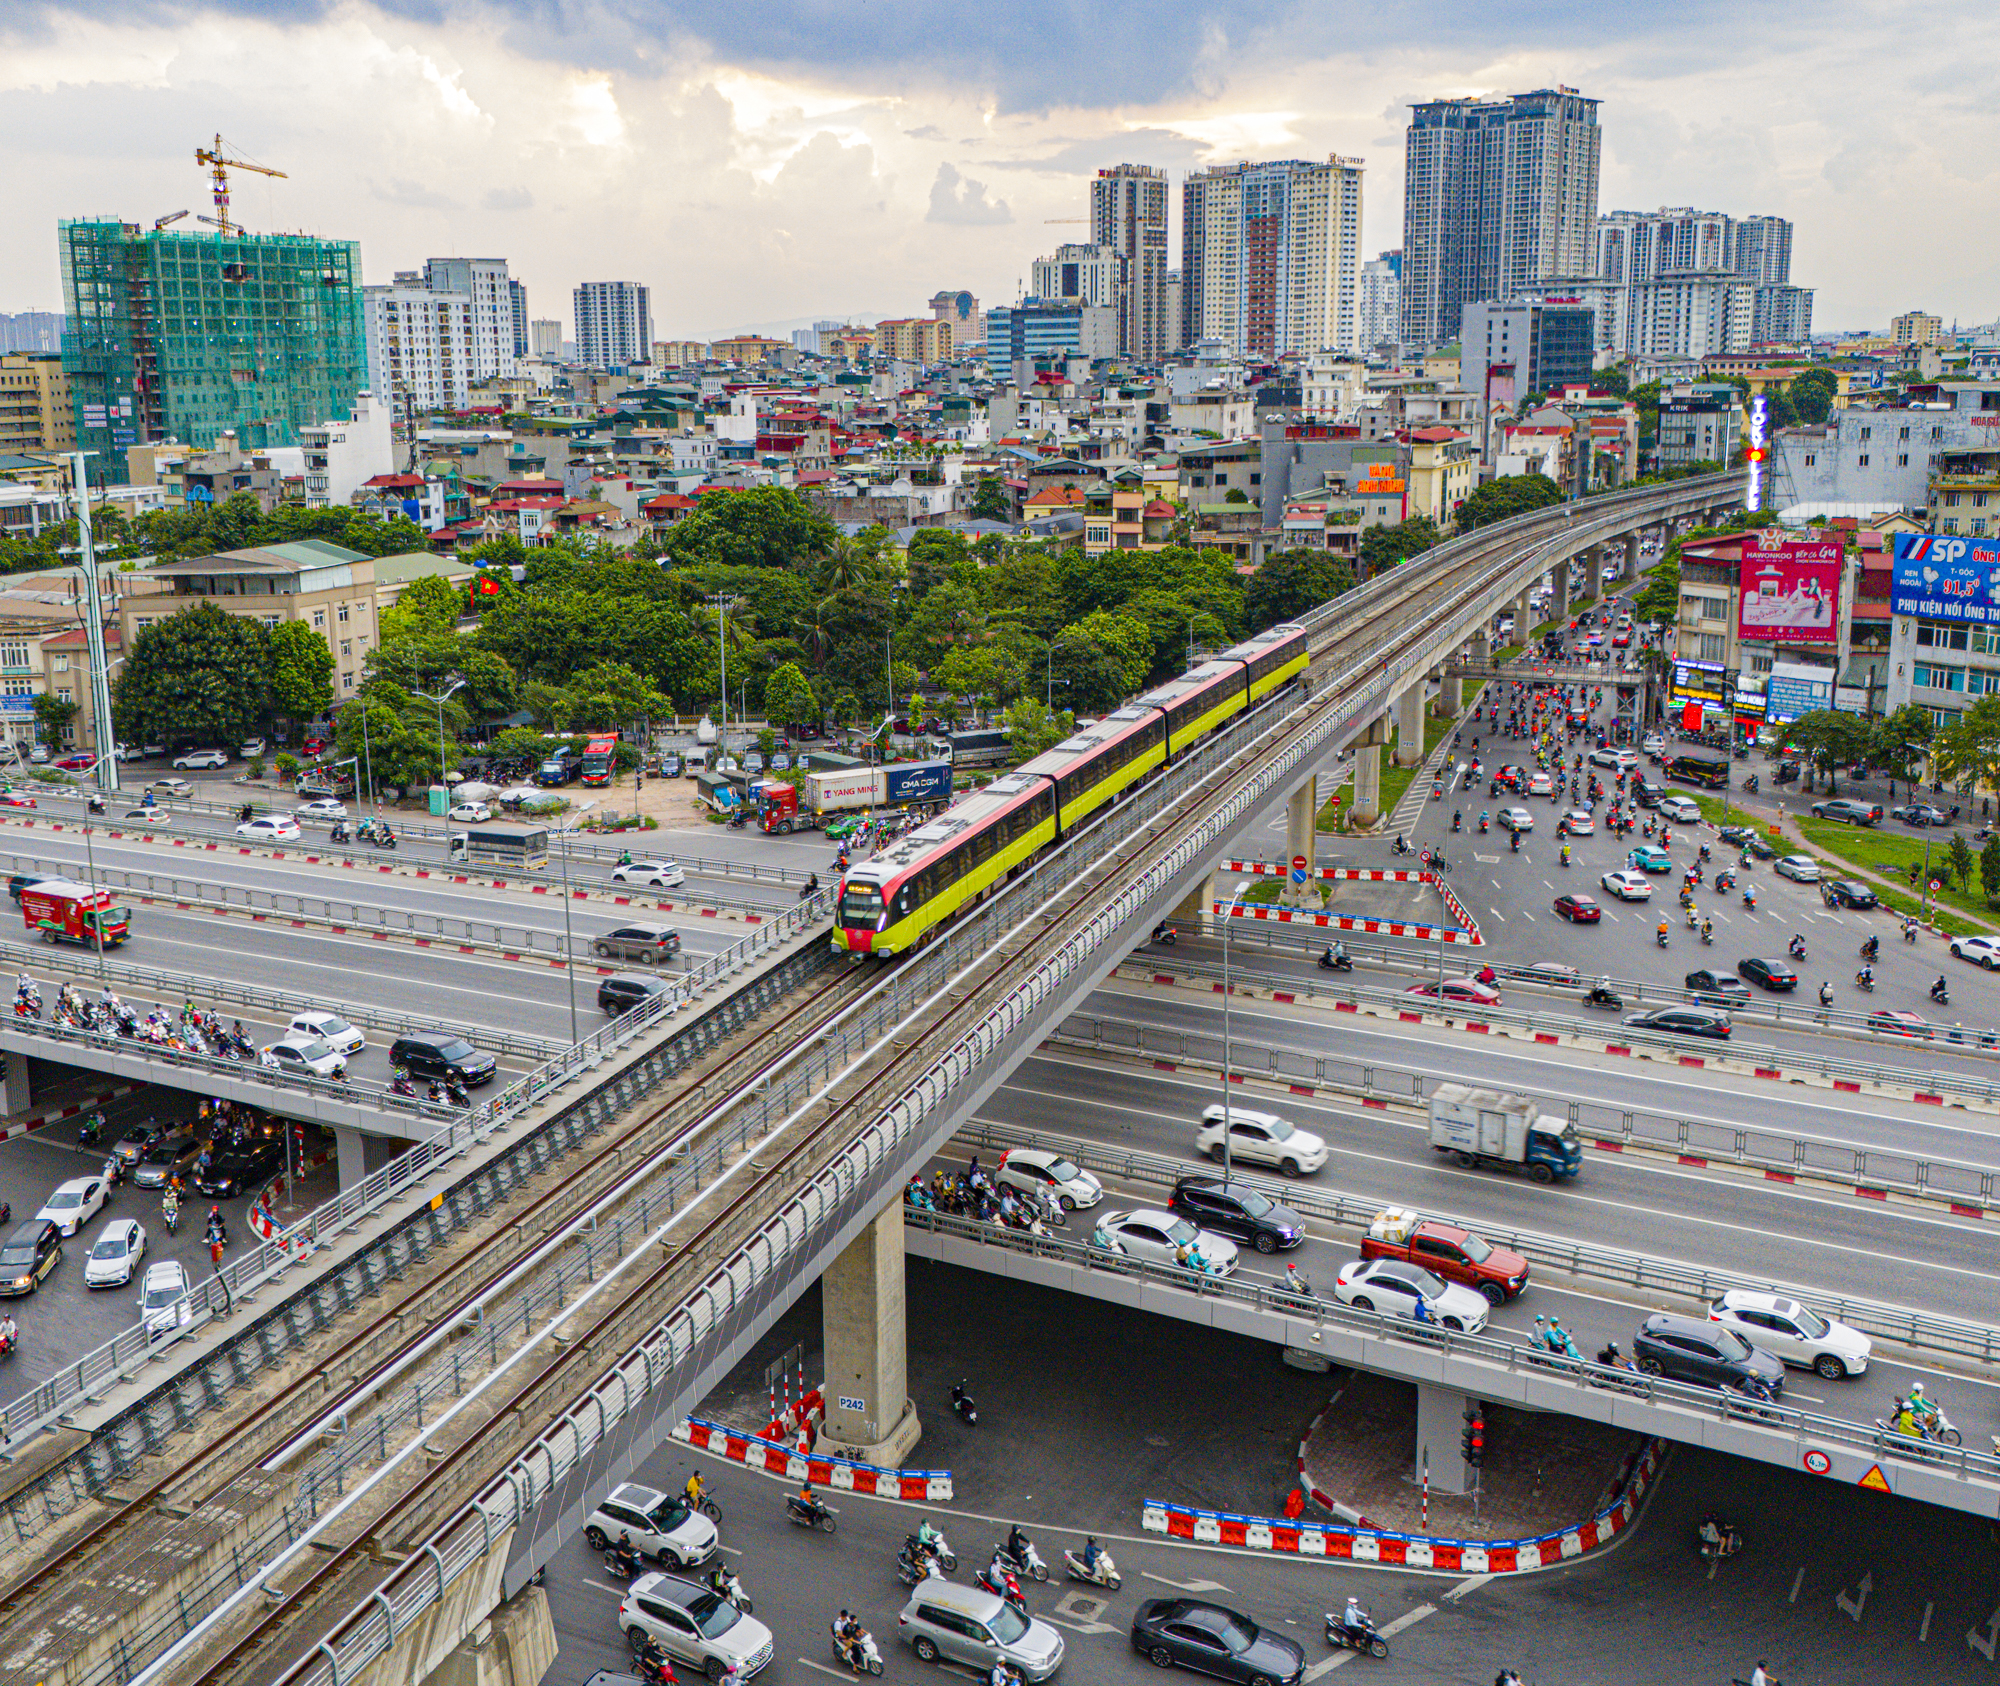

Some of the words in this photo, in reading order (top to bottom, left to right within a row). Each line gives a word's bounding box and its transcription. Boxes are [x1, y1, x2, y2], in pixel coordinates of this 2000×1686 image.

[1746, 552, 1792, 560] HAWONKOO
[1932, 539, 1966, 562] SP
[1905, 569, 1918, 577] REN
[1898, 598, 1917, 615] PHỤ
[1920, 599, 1942, 616] KIỆN
[1944, 601, 1962, 617] NỐI
[1964, 601, 1985, 619] ỐNG
[901, 780, 919, 789] CMA
[920, 777, 939, 787] CGM
[833, 788, 855, 797] YANG
[857, 785, 878, 794] MING
[840, 1398, 863, 1411] P242
